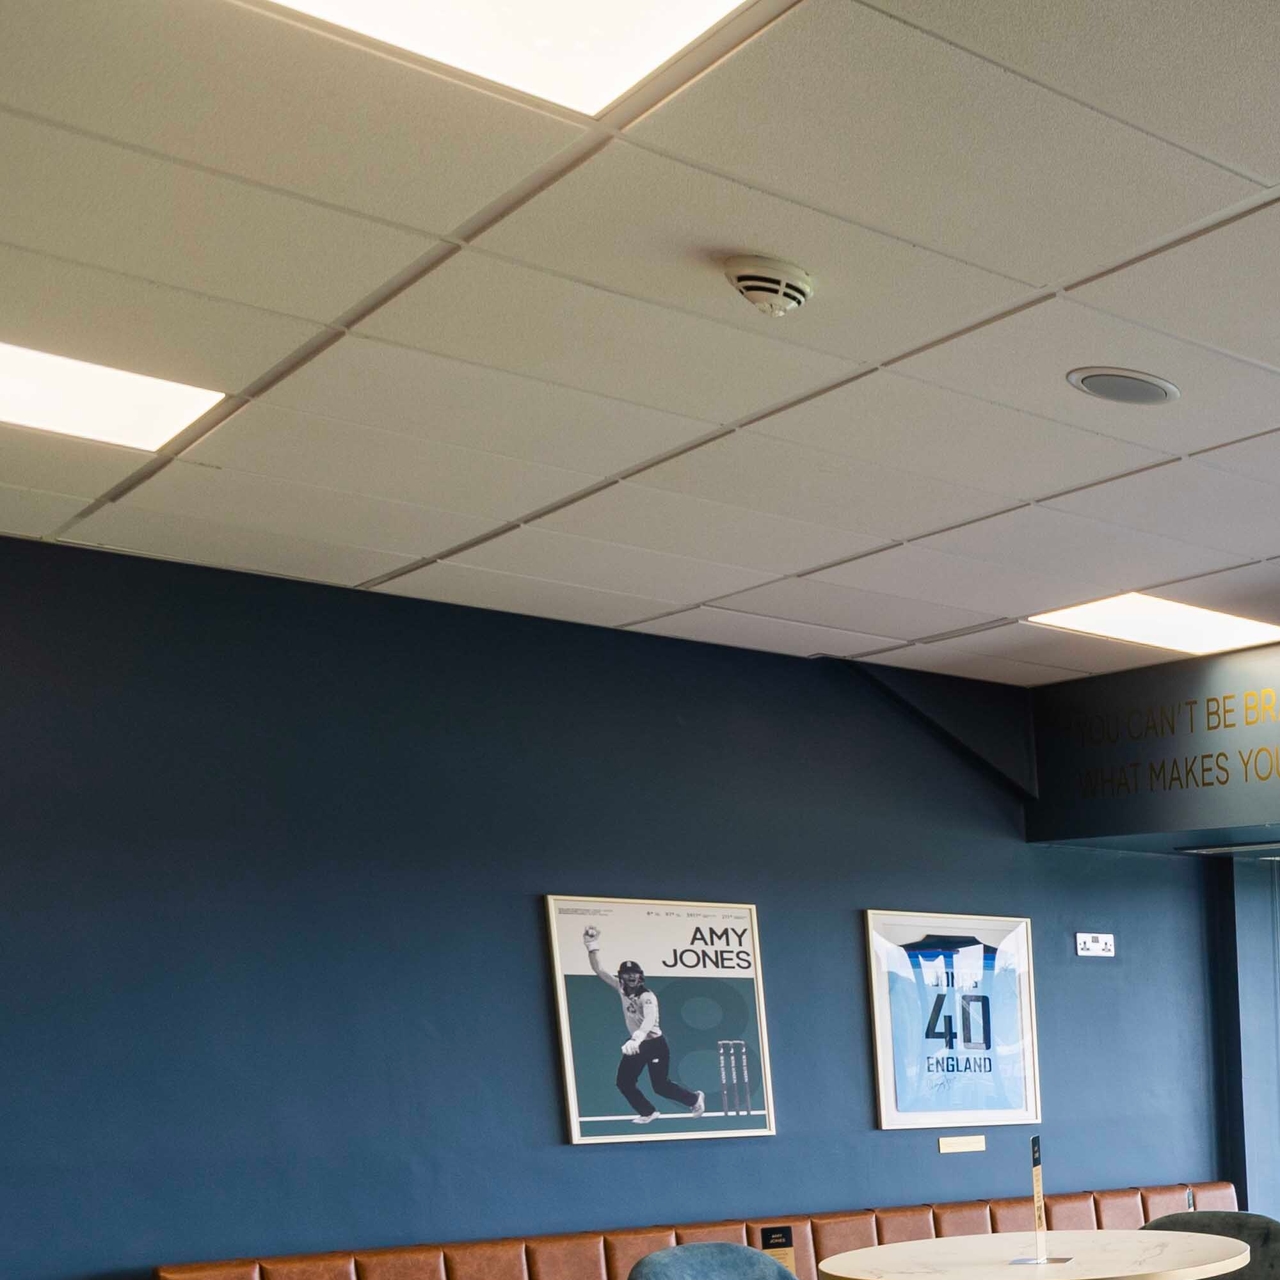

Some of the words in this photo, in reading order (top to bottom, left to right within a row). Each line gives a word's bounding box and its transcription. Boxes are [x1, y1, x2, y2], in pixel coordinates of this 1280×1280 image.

[1127, 700, 1198, 740] CAN'T
[1206, 694, 1237, 731] BE
[1077, 763, 1142, 799] WHAT
[1149, 751, 1230, 792] MAKES
[690, 926, 748, 947] AMY
[661, 948, 752, 970] JONES
[924, 993, 992, 1051] 40
[926, 1056, 992, 1073] ENGLAND
